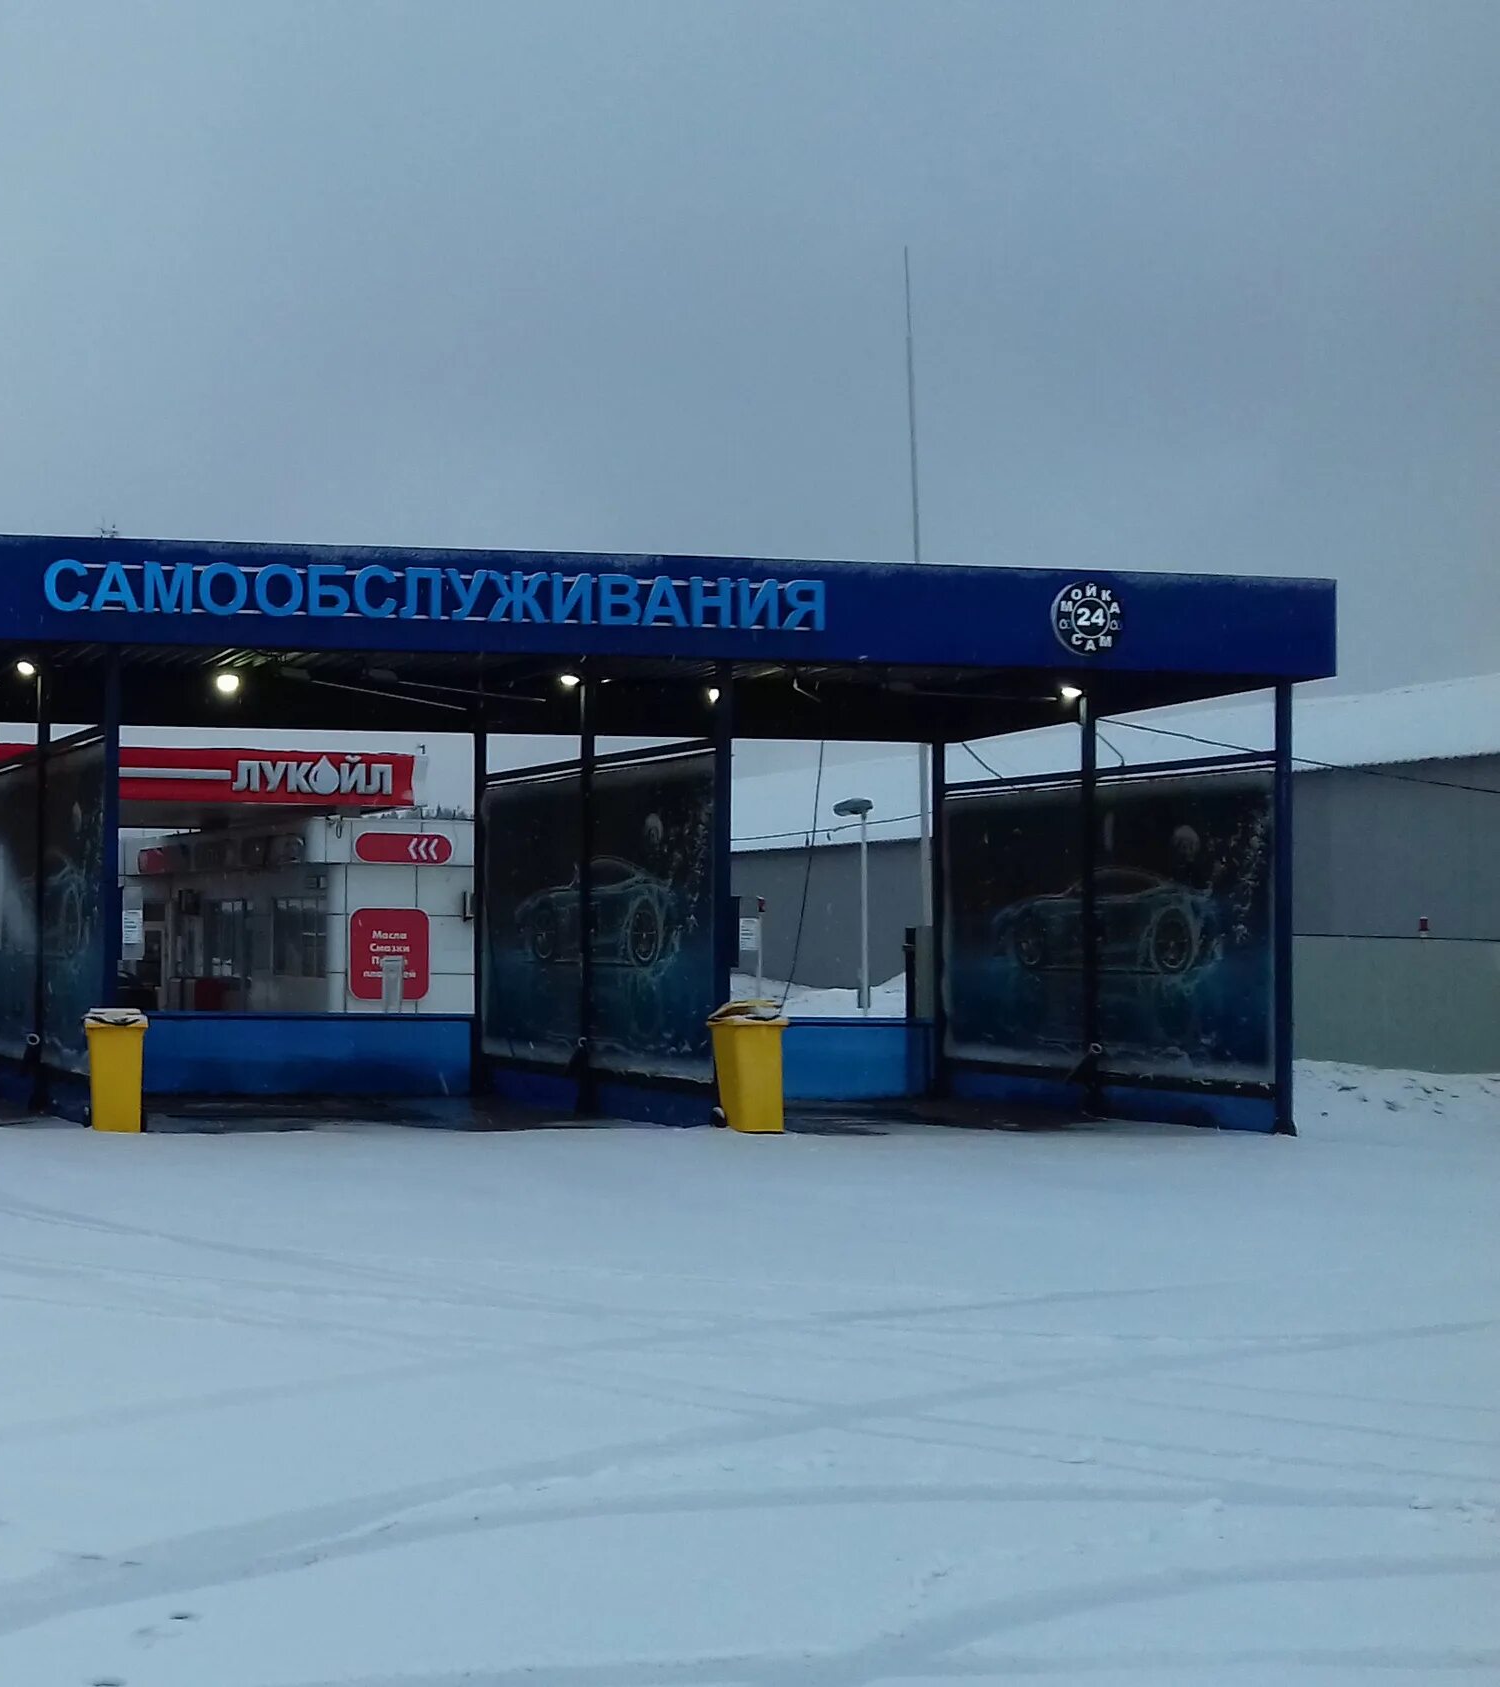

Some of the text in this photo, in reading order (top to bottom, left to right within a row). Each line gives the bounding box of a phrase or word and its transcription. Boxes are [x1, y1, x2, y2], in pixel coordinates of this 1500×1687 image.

[43, 558, 825, 631] САМООБСЛУЖИВАНИЯ
[1059, 582, 1121, 614] МОЙКА
[1076, 607, 1106, 627] 24
[1070, 633, 1113, 651] САМ
[232, 755, 393, 796] ЛУКОЙЛ
[372, 930, 408, 940] Масла
[369, 943, 410, 953] Смазки
